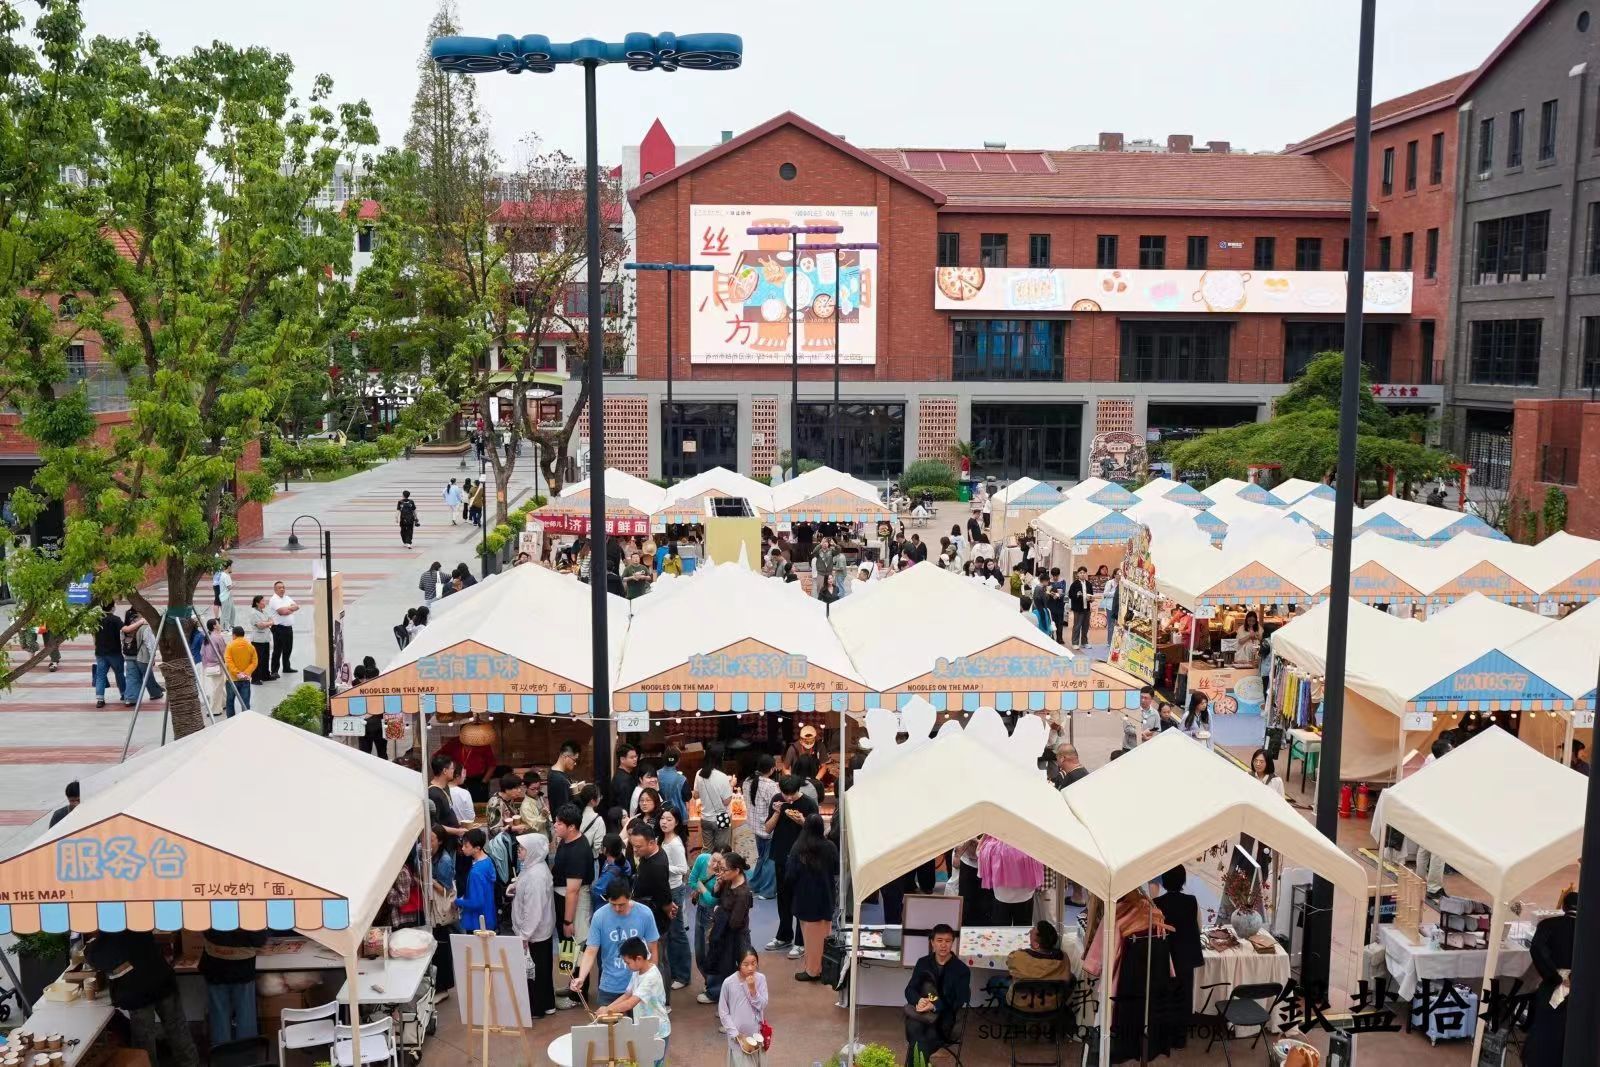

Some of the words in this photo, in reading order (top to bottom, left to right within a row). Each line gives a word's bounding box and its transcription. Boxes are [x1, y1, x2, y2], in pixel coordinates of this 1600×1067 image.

[402, 686, 416, 694] THE
[683, 683, 696, 691] THE
[948, 683, 961, 691] THE
[343, 721, 355, 732] 21
[627, 717, 639, 727] 20
[58, 838, 187, 881] 服务台
[0, 891, 10, 901] N
[12, 891, 34, 900] THE
